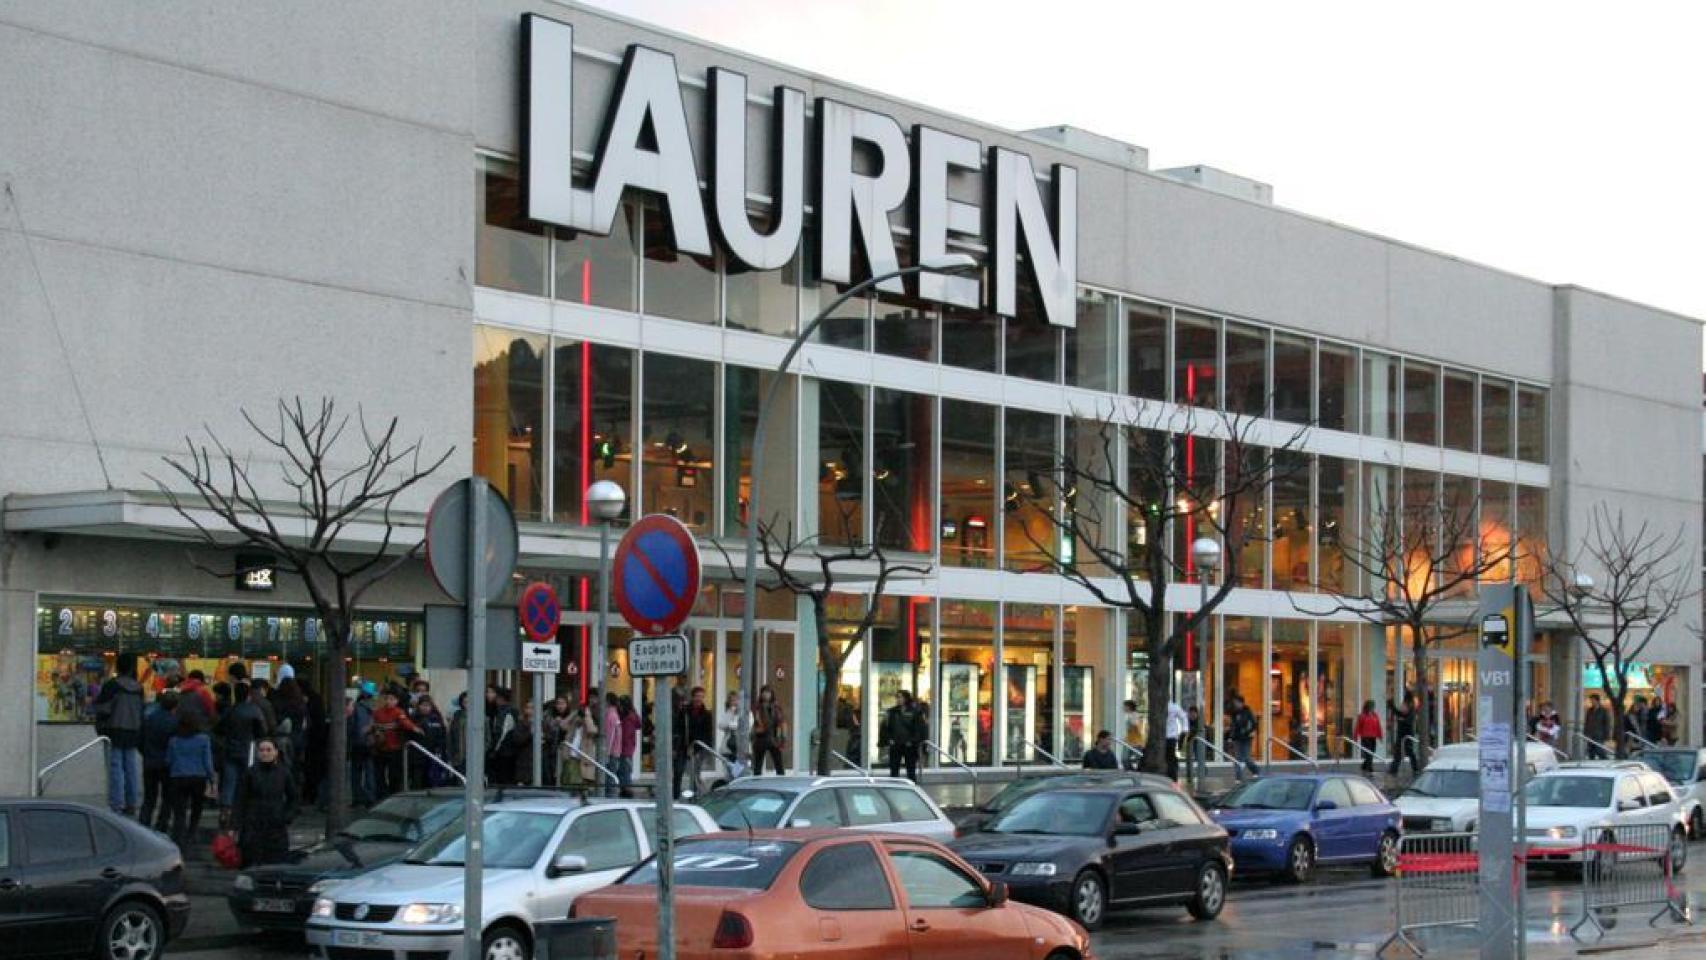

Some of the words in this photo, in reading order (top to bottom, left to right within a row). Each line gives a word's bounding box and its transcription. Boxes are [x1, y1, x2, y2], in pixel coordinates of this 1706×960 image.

[521, 13, 1077, 328] LAUREN
[58, 608, 73, 635] 2
[103, 609, 117, 636] 3
[145, 612, 159, 638] 4
[187, 613, 201, 640] 5
[228, 615, 241, 640] 6
[267, 617, 279, 641] 7
[634, 643, 677, 657] Excepte
[633, 659, 681, 671] Turismes
[1480, 670, 1510, 686] VB1
